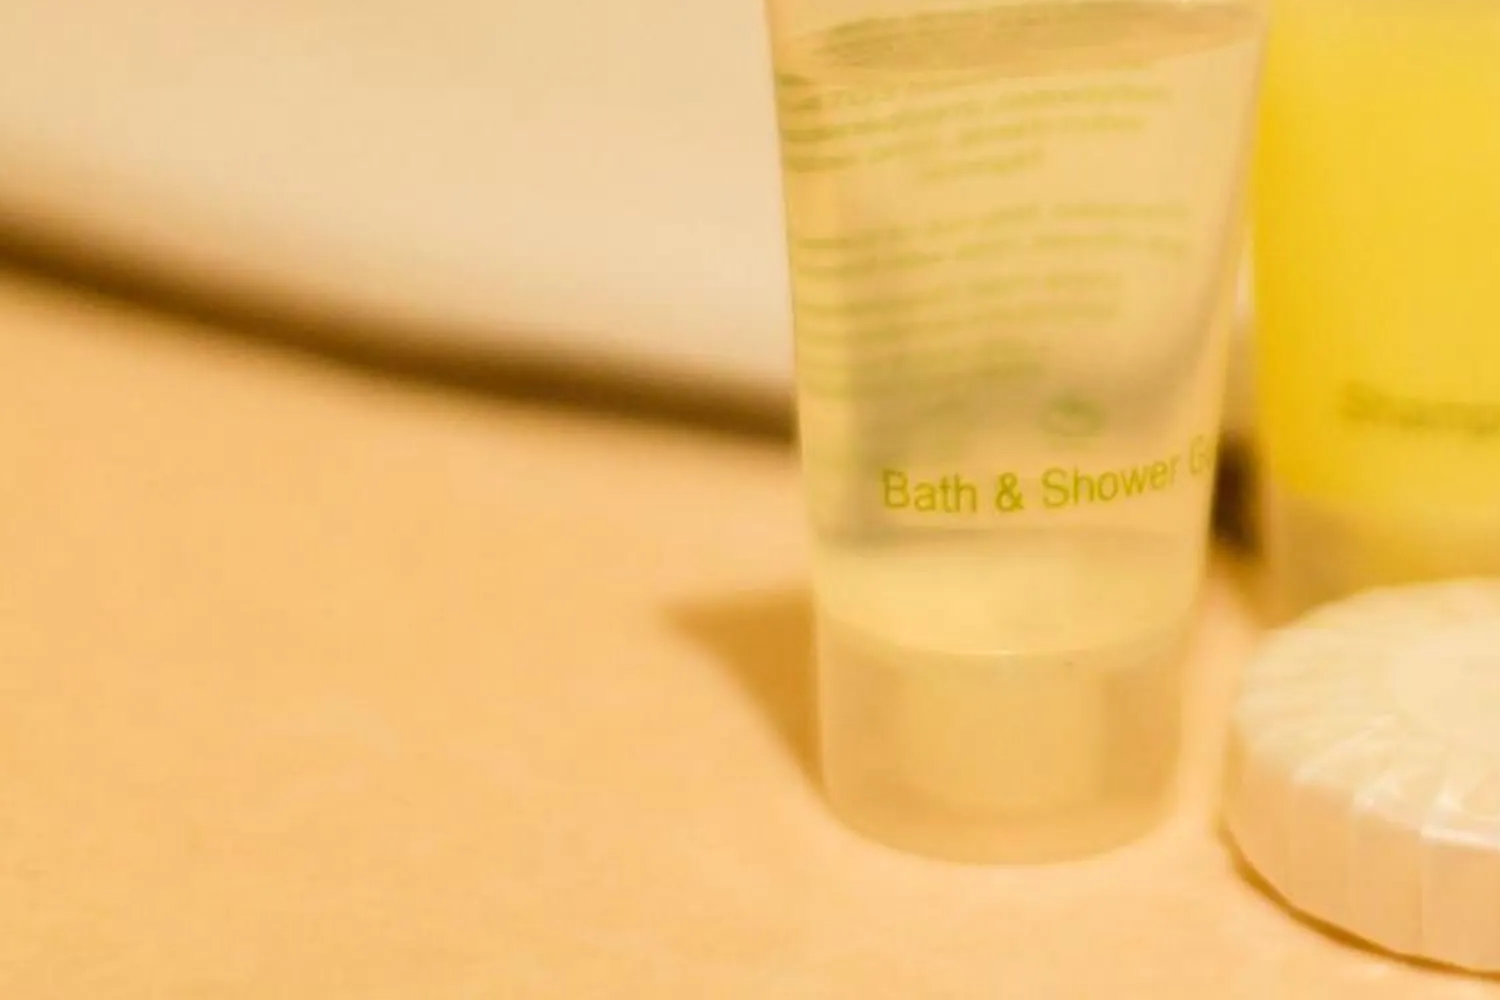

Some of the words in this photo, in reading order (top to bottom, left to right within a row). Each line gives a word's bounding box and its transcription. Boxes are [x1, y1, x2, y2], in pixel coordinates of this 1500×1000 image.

[882, 468, 977, 514] Bath
[994, 471, 1025, 513] &
[1041, 454, 1181, 509] Shower
